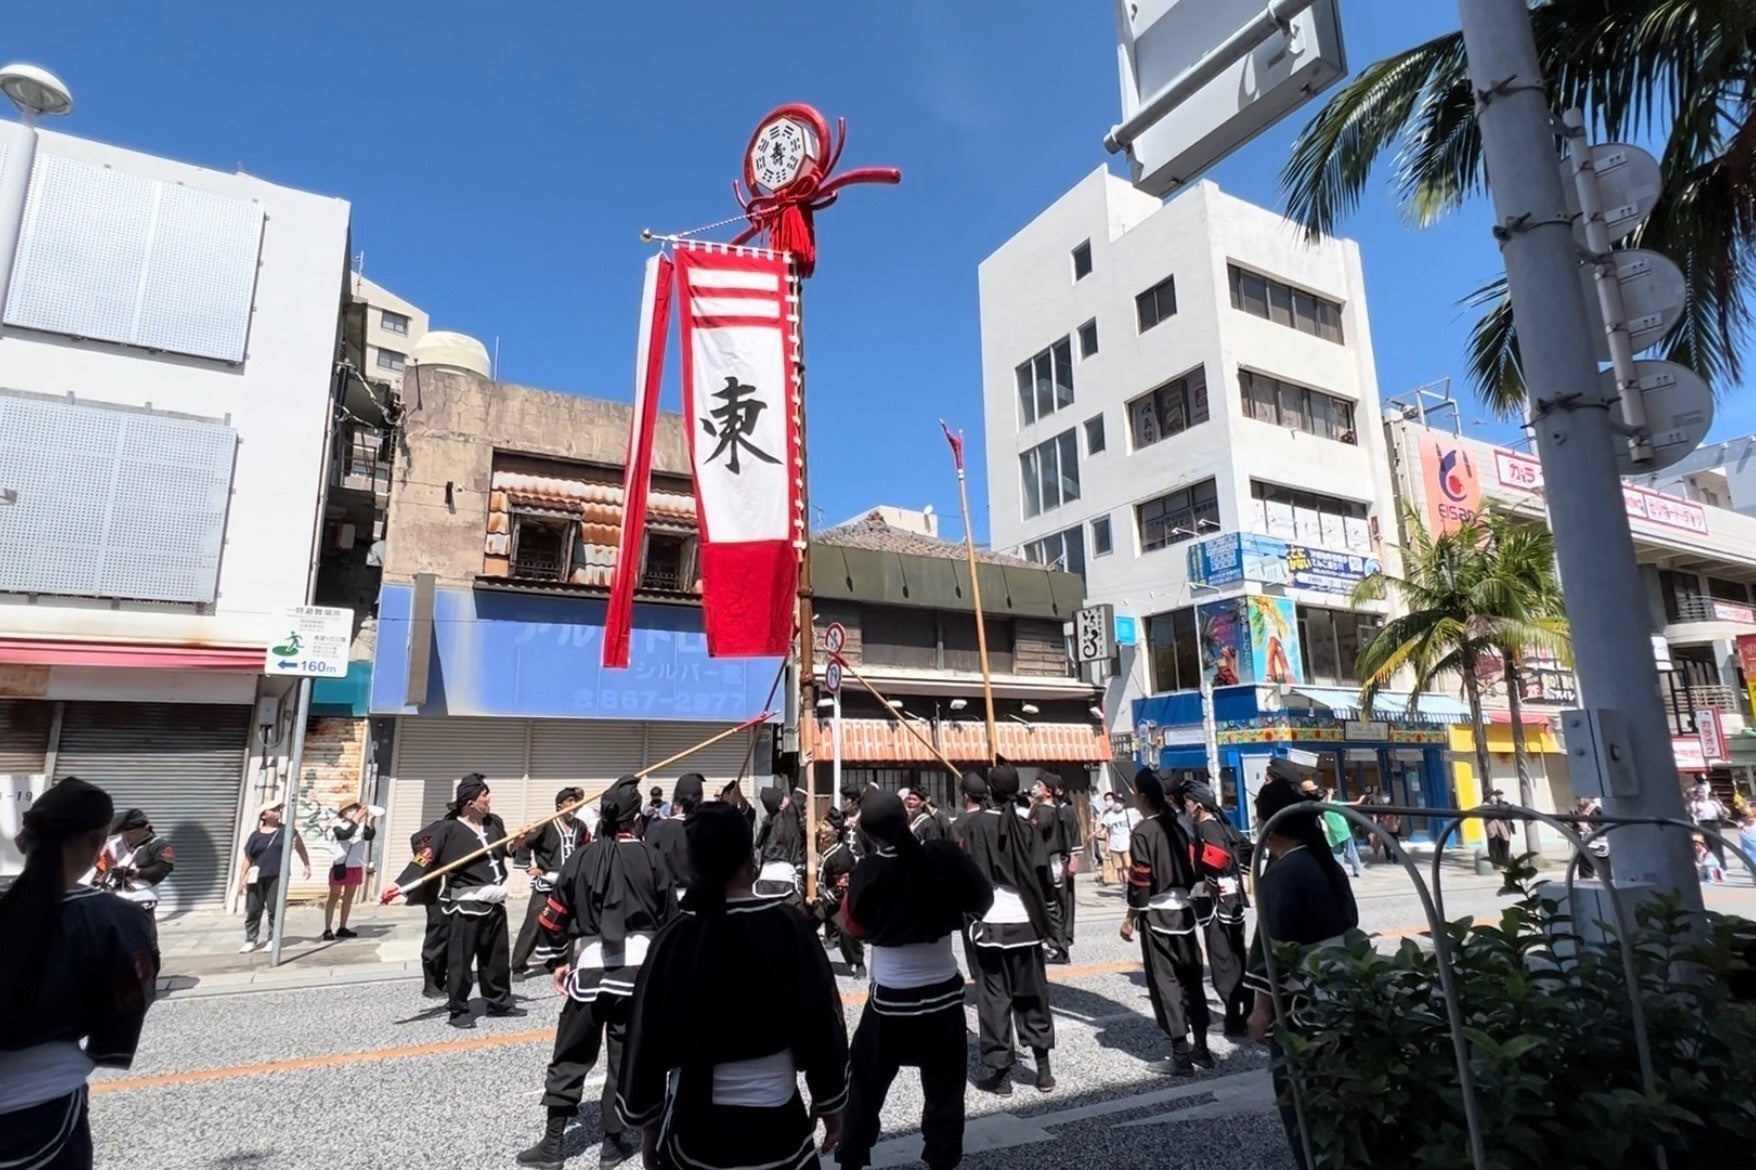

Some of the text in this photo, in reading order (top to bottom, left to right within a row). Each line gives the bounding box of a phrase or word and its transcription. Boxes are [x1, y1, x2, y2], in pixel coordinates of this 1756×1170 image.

[698, 375, 785, 476] 東
[300, 660, 337, 673] 160m
[0, 790, 33, 802] -19
